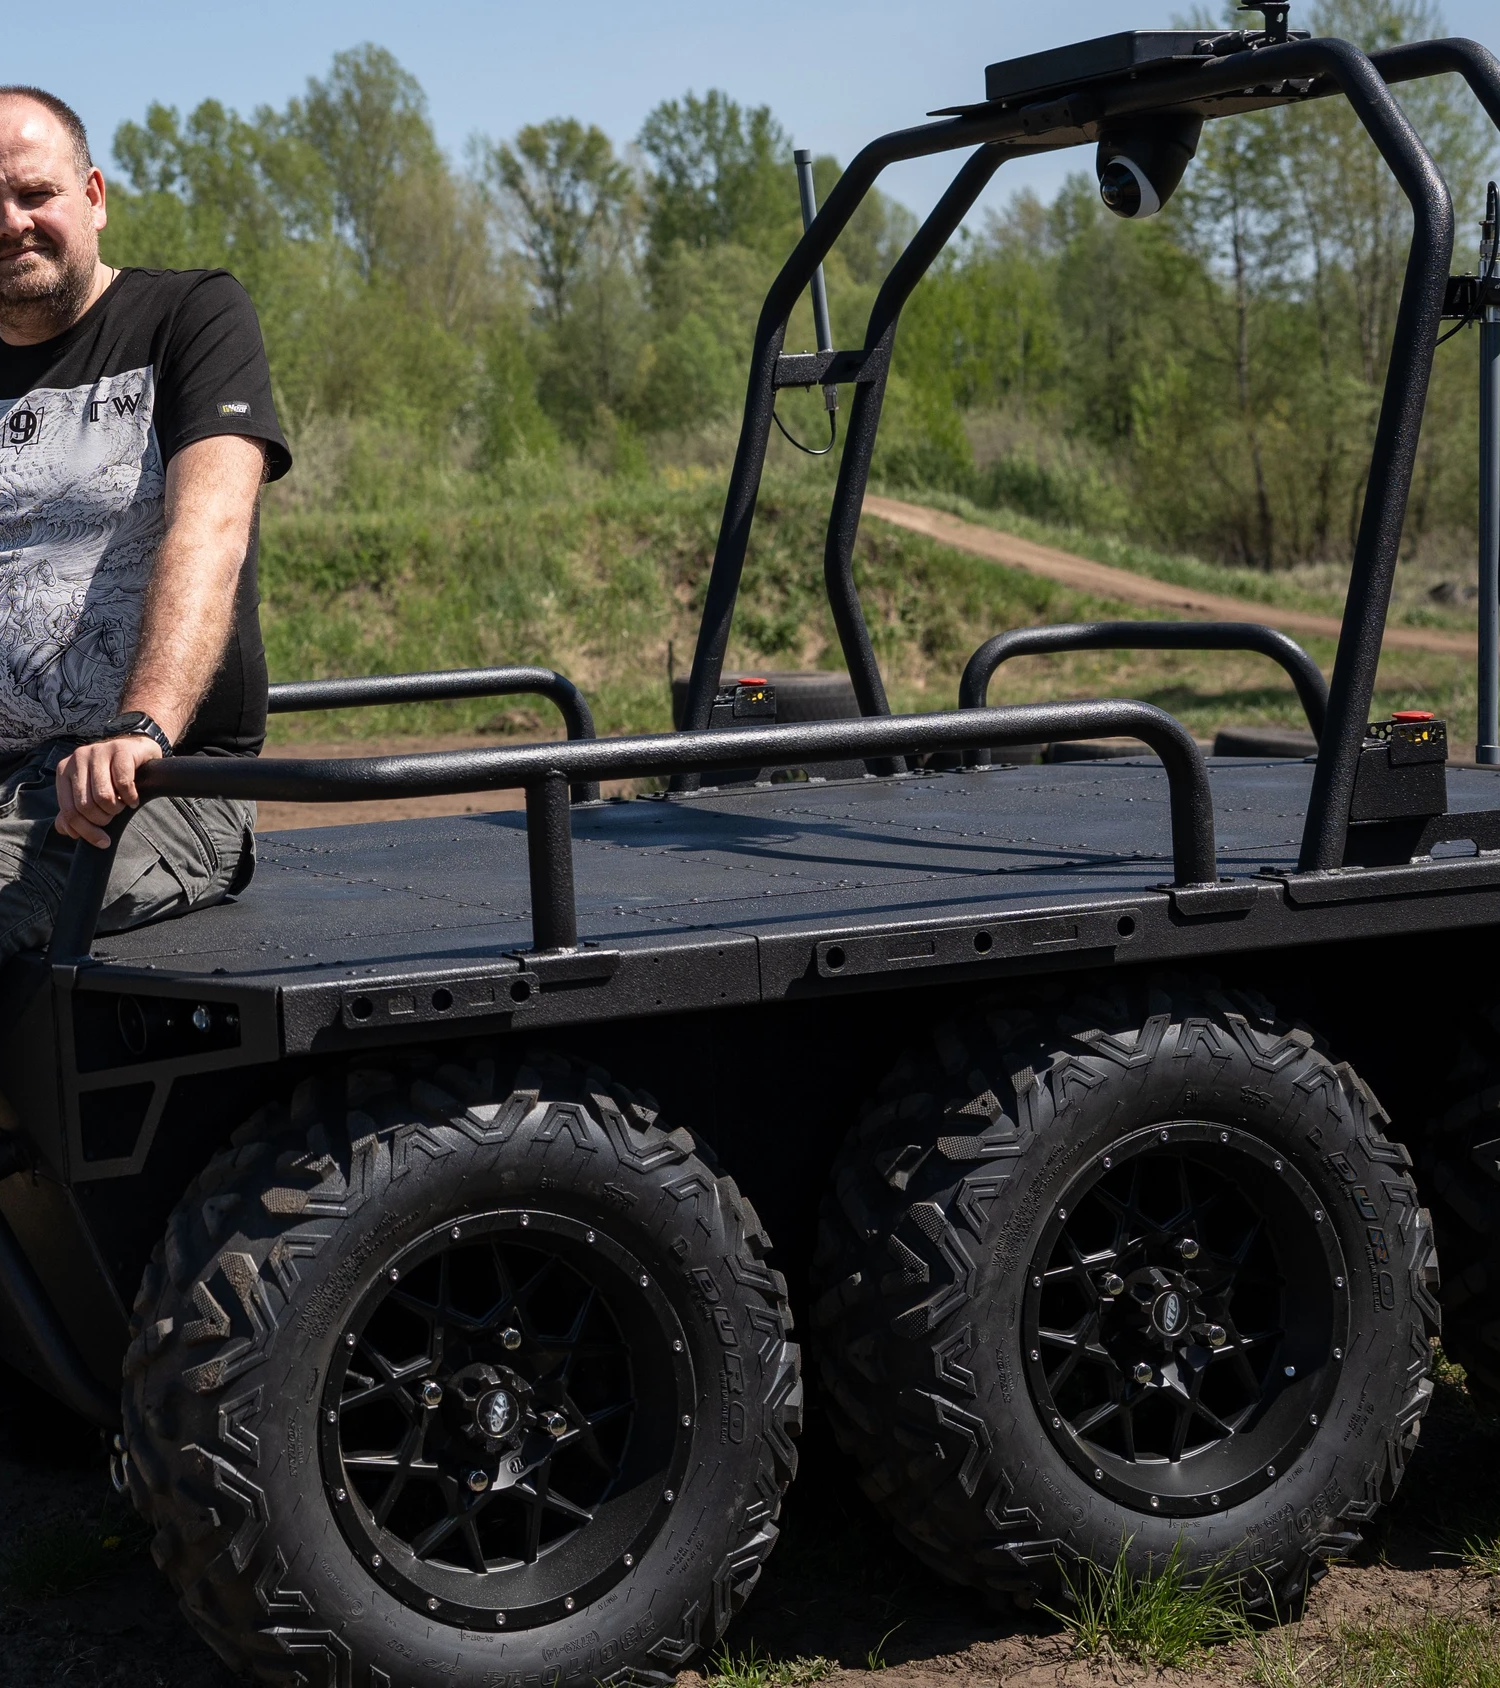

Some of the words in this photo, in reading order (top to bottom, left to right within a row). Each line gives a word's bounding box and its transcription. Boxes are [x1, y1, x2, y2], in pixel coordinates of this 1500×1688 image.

[9, 410, 37, 444] 9
[1334, 1151, 1395, 1310] DURO
[296, 1283, 325, 1330] WARNING
[1163, 1293, 1178, 1333] ITP
[691, 1267, 745, 1444] DURO
[541, 1629, 601, 1662] (27X9-14)
